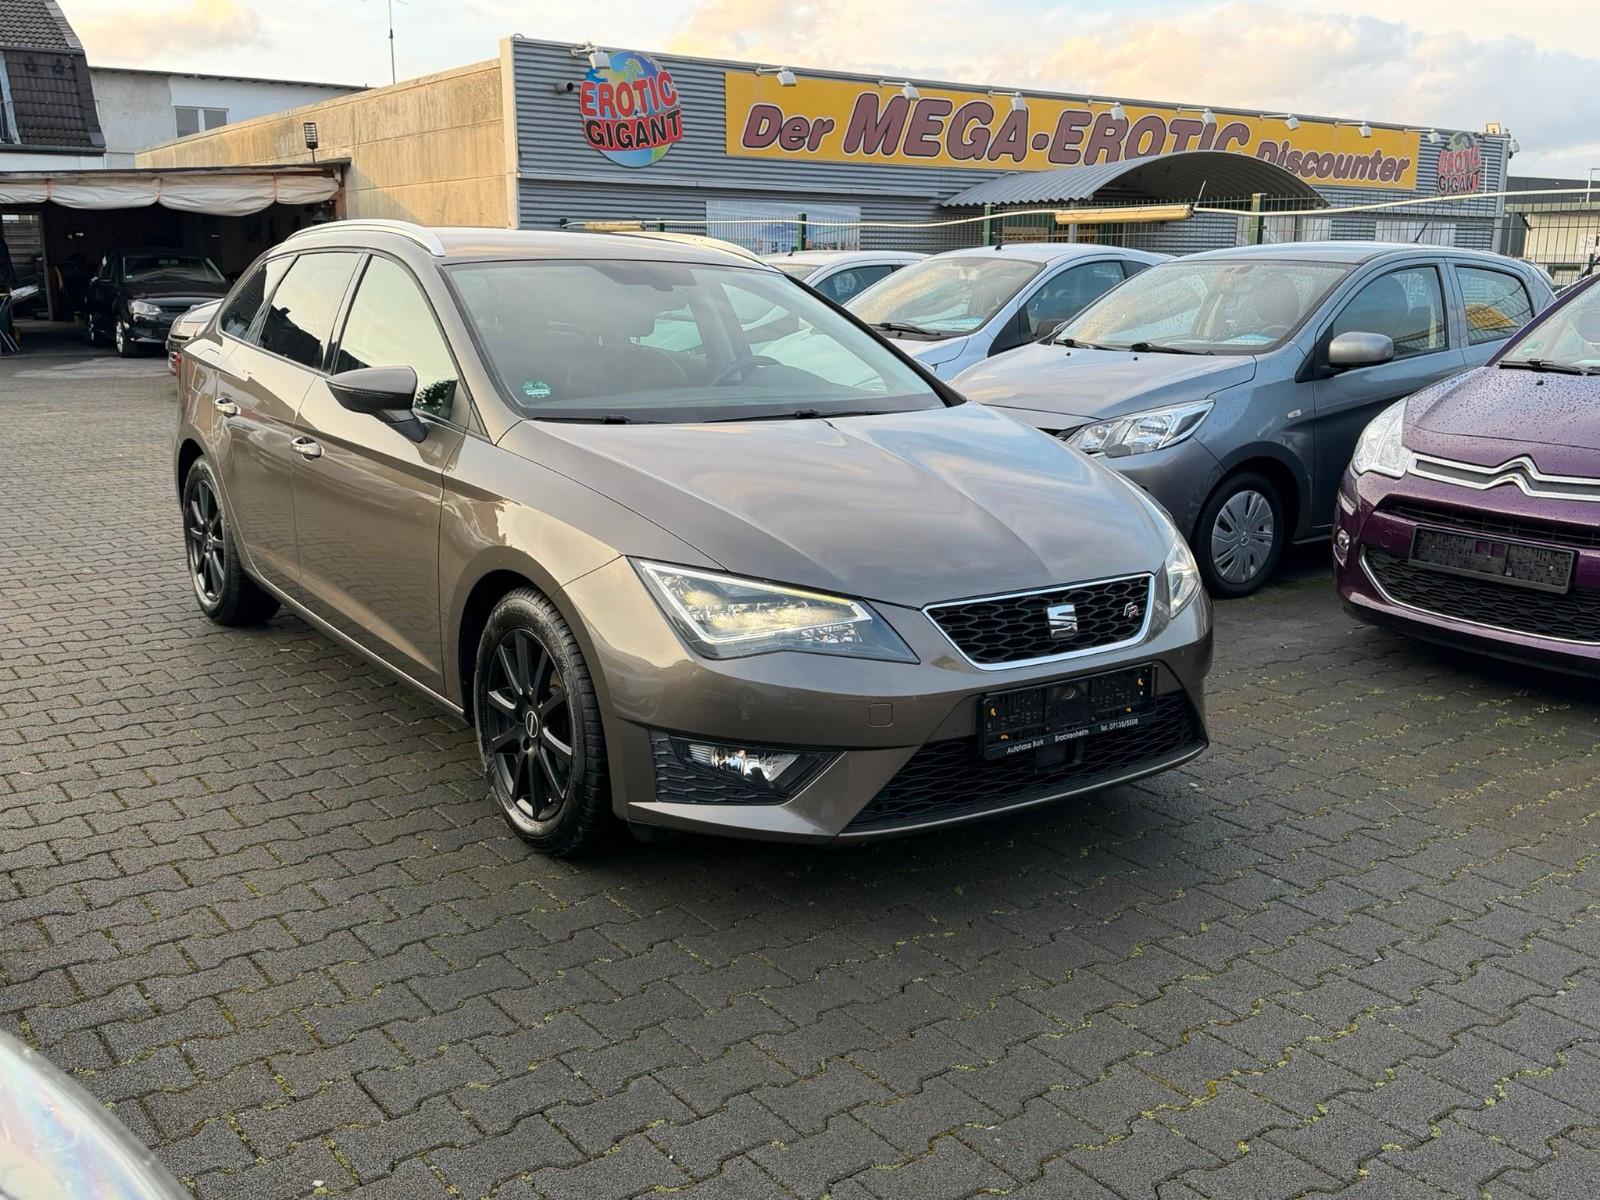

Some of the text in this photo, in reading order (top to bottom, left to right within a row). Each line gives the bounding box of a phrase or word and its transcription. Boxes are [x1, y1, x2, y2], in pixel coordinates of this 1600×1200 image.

[580, 71, 679, 119] EROTIC
[584, 108, 682, 151] GIGANT
[741, 92, 1411, 184] Der MEGA-EROTIC Discounter
[1438, 169, 1481, 194] GIGANT
